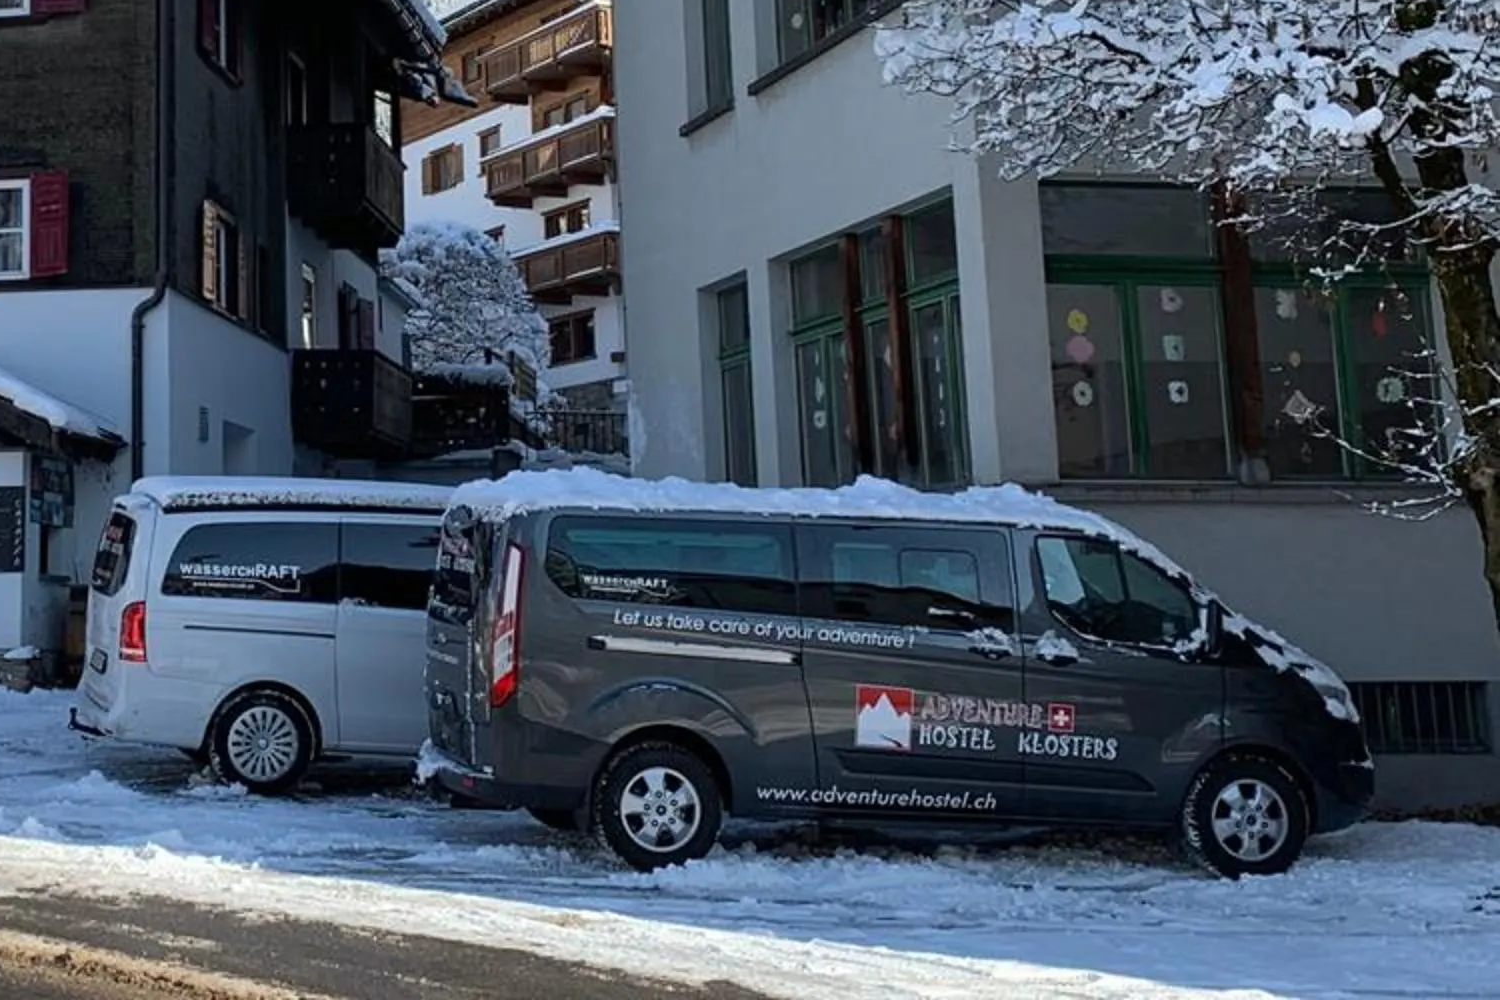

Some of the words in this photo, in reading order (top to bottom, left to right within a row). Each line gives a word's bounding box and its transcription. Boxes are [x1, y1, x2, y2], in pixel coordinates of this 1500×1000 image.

[613, 608, 640, 625] Let
[644, 613, 664, 627] us
[667, 613, 704, 631] take
[709, 617, 750, 635] care
[754, 621, 772, 636] of
[776, 624, 813, 640] your
[817, 626, 905, 648] adventure
[920, 695, 1043, 729] ADVENTURE
[918, 722, 996, 751] HOSTEL
[1017, 732, 1119, 761] KLOSTERS
[756, 785, 997, 810] www.adventurehostel.ch
